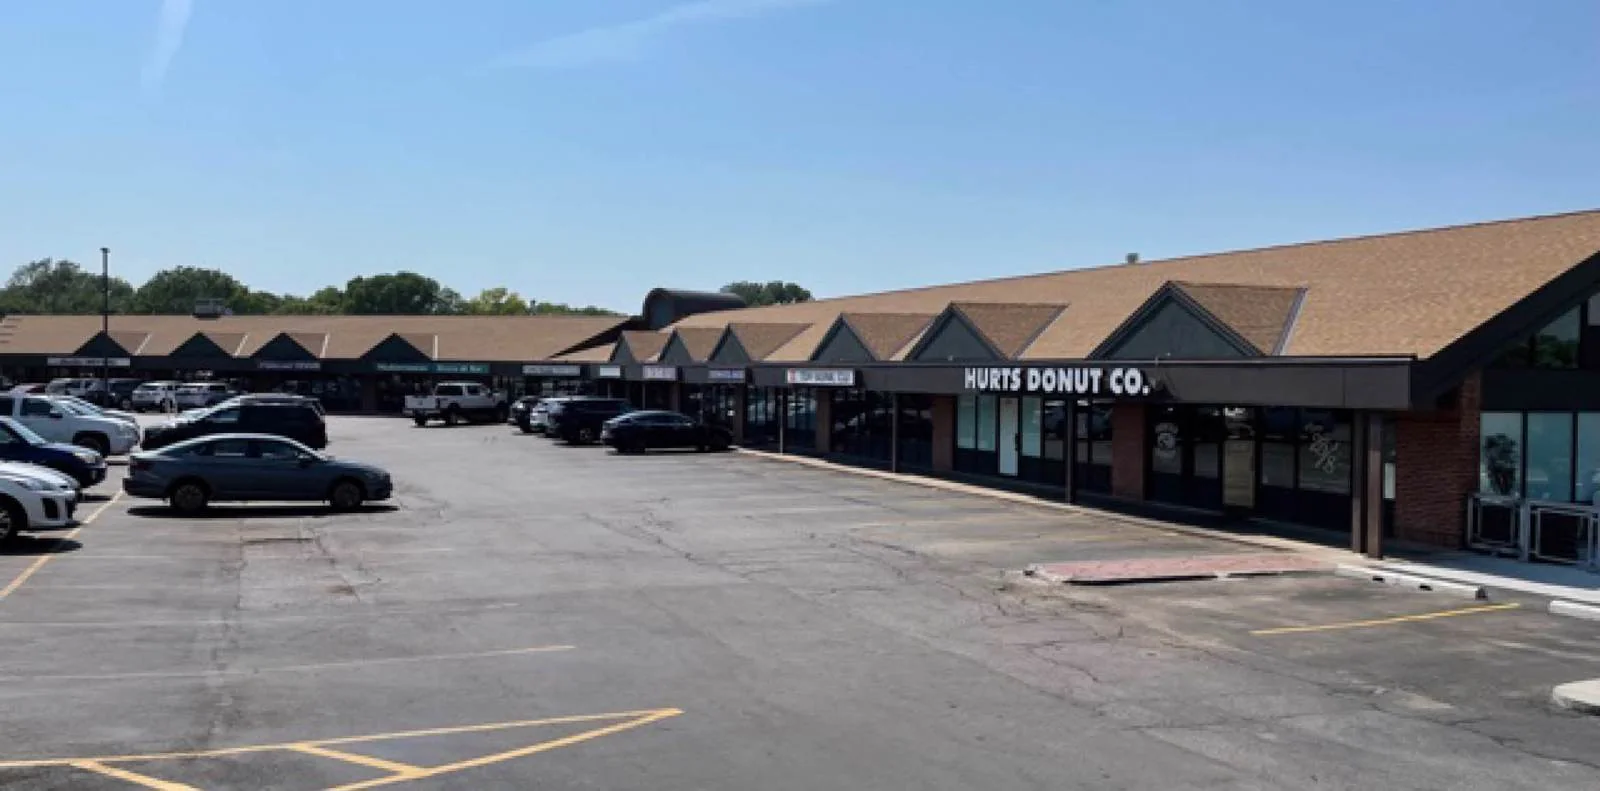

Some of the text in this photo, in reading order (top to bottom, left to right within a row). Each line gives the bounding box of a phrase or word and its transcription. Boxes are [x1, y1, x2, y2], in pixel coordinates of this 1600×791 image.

[964, 367, 1151, 395] HURTS DONUT CO.
